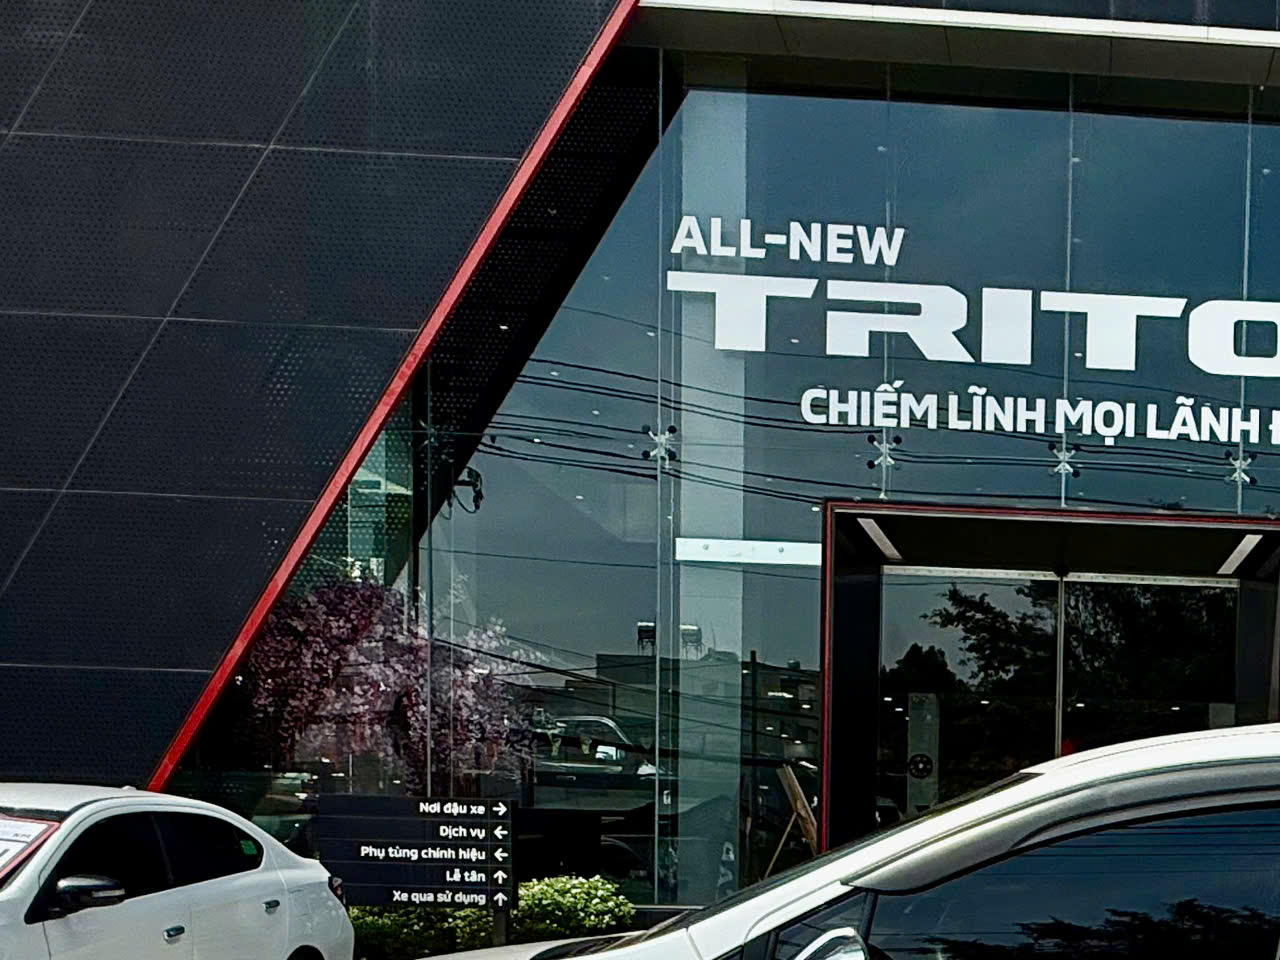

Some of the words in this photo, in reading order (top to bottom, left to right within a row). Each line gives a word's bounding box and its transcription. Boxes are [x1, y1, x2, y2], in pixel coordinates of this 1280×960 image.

[670, 214, 905, 266] ALL-NEW
[801, 380, 938, 430] CHIẾM
[946, 386, 1047, 434] LĨNH
[1055, 398, 1136, 447] MỌI
[1144, 396, 1256, 444] LÃNH
[419, 802, 441, 814] Nơi
[443, 803, 468, 816] đậu
[470, 804, 486, 815] xe
[439, 825, 467, 839] Dịch
[469, 827, 486, 840] vụ
[360, 845, 385, 860] Phụ
[388, 845, 419, 861] tùng
[421, 847, 456, 860] chính
[459, 848, 486, 862] hiệu
[464, 870, 486, 882] tân
[393, 890, 409, 902] Xe
[411, 892, 434, 904] qua
[437, 889, 452, 902] sử
[455, 891, 486, 906] dụng
